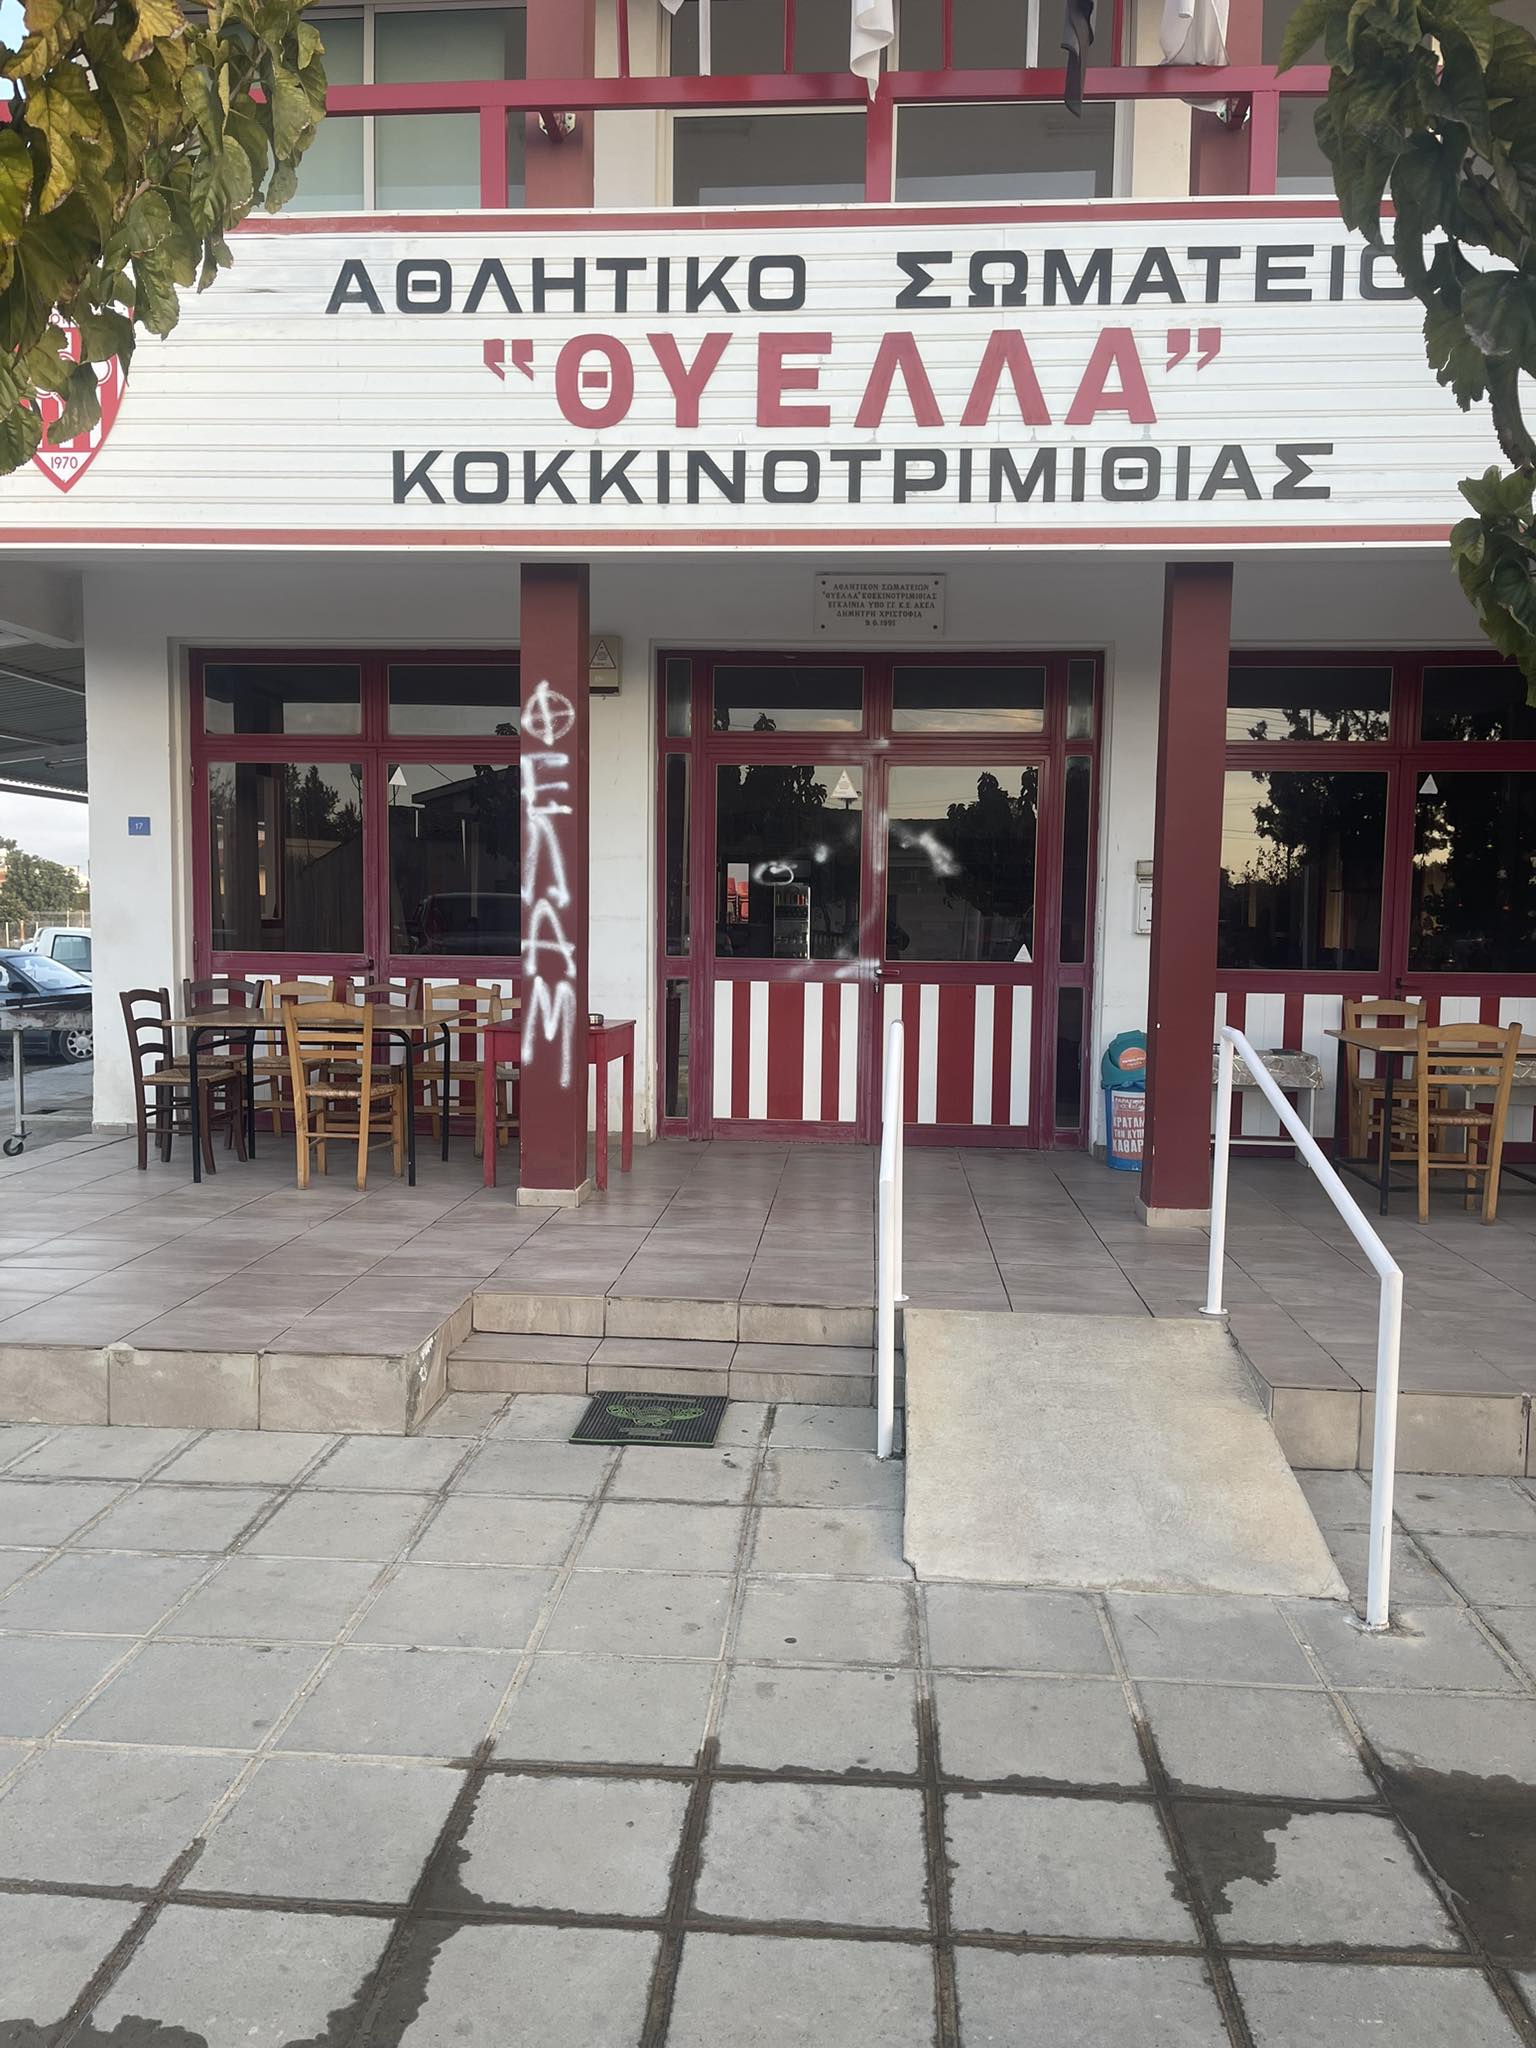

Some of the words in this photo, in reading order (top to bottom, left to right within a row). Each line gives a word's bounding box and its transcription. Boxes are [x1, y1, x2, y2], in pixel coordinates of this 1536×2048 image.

[326, 255, 805, 314] ΑΘΛΗΤΙΚΟ
[896, 244, 1415, 308] ΣΩΜΑΤΕΙΟ
[50, 456, 79, 470] 1970
[393, 443, 1334, 504] ΚΟΚΚΙΝΟΤΡΙΜΙΘΙΑΣ
